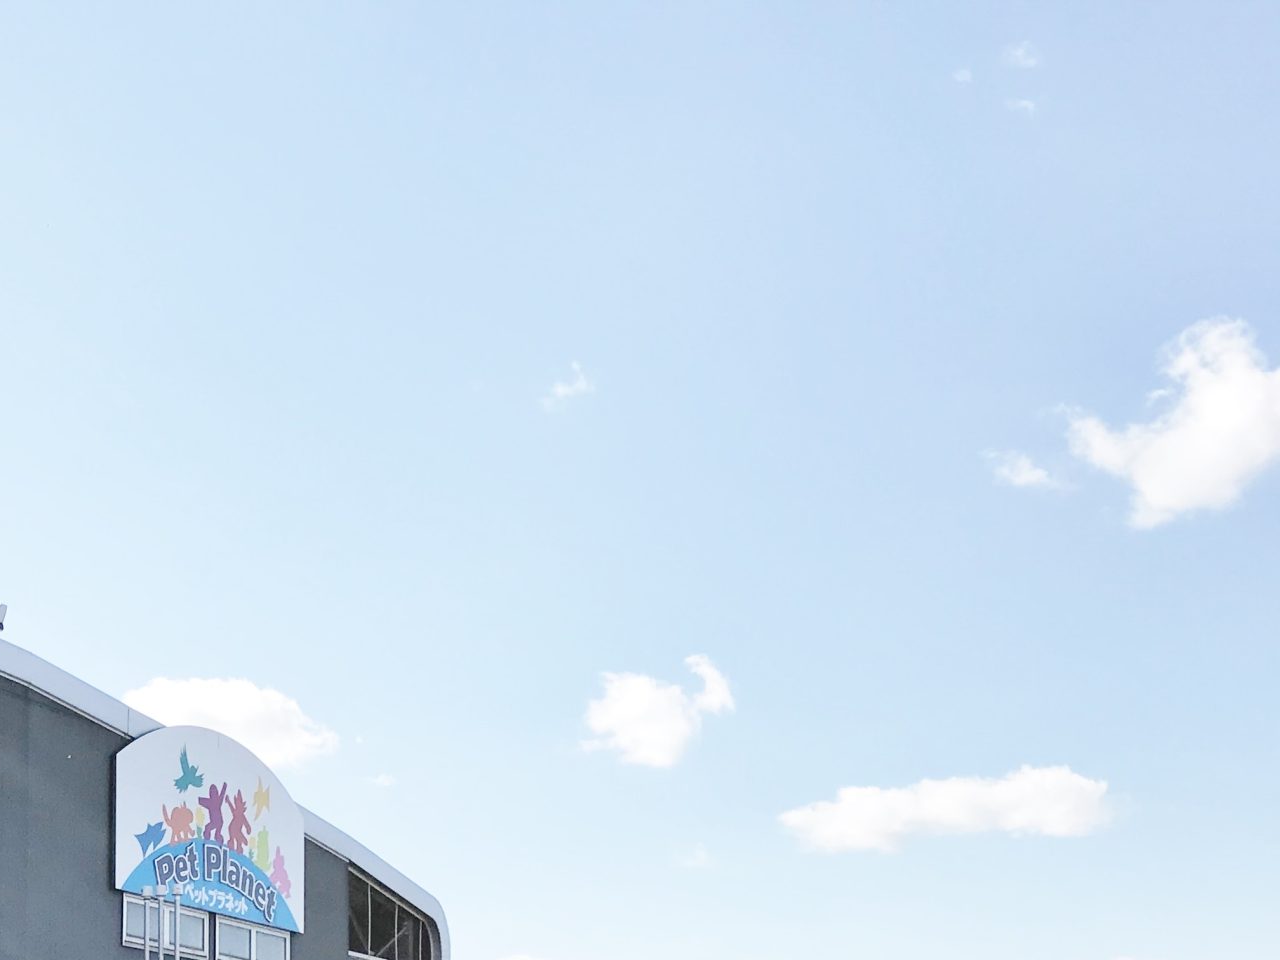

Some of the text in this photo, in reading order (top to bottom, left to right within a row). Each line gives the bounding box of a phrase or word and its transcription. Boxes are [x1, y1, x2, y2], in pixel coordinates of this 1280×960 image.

[154, 841, 277, 923] Pet Planet
[184, 882, 249, 915] ペットプラネット
